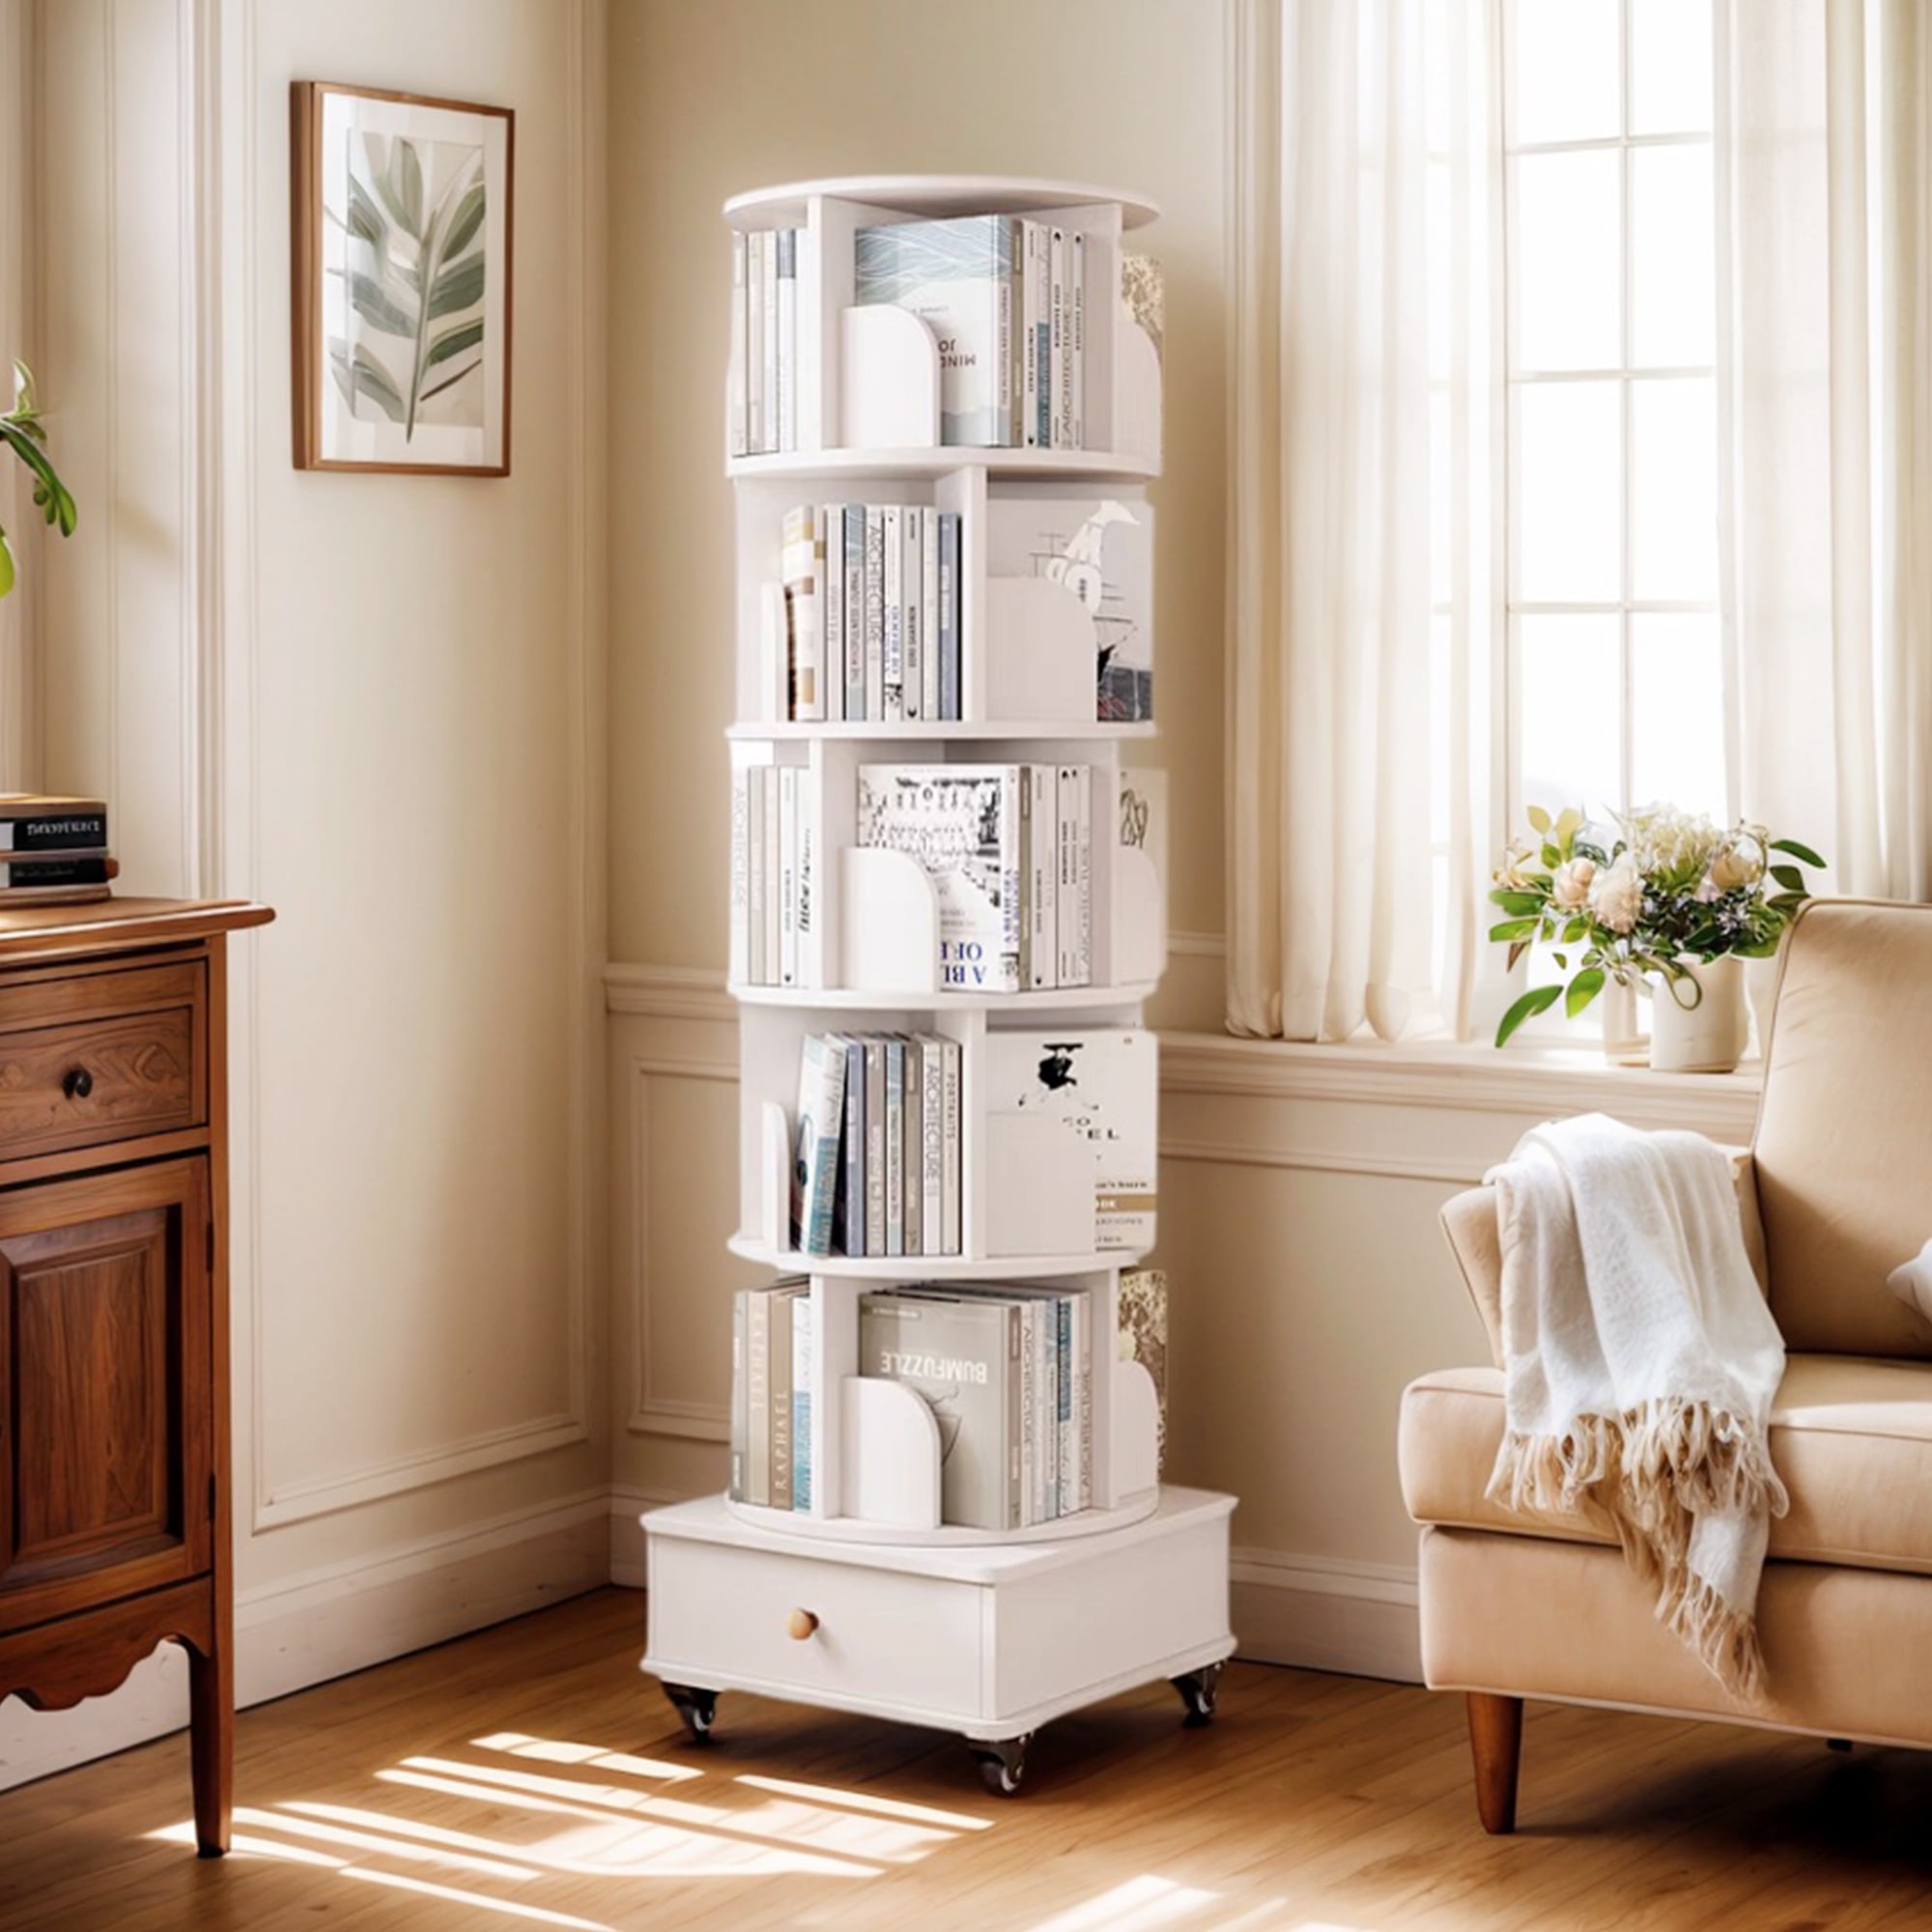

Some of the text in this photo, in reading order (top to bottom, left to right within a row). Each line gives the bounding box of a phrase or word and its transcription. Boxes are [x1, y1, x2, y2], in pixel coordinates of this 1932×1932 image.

[1062, 311, 1072, 436] ARCHITECTURE
[868, 526, 883, 642] ARCHITECTURE
[733, 788, 747, 907] ARCHITECTURE
[925, 1064, 940, 1179] ARCHITECTURE
[946, 1073, 956, 1140] PORTRAITS
[1076, 1128, 1121, 1140] EL
[880, 1350, 988, 1384] BUMFUZZLE
[1023, 1326, 1033, 1444] ARCHITECTURE
[774, 1390, 788, 1491] RAPHAEL
